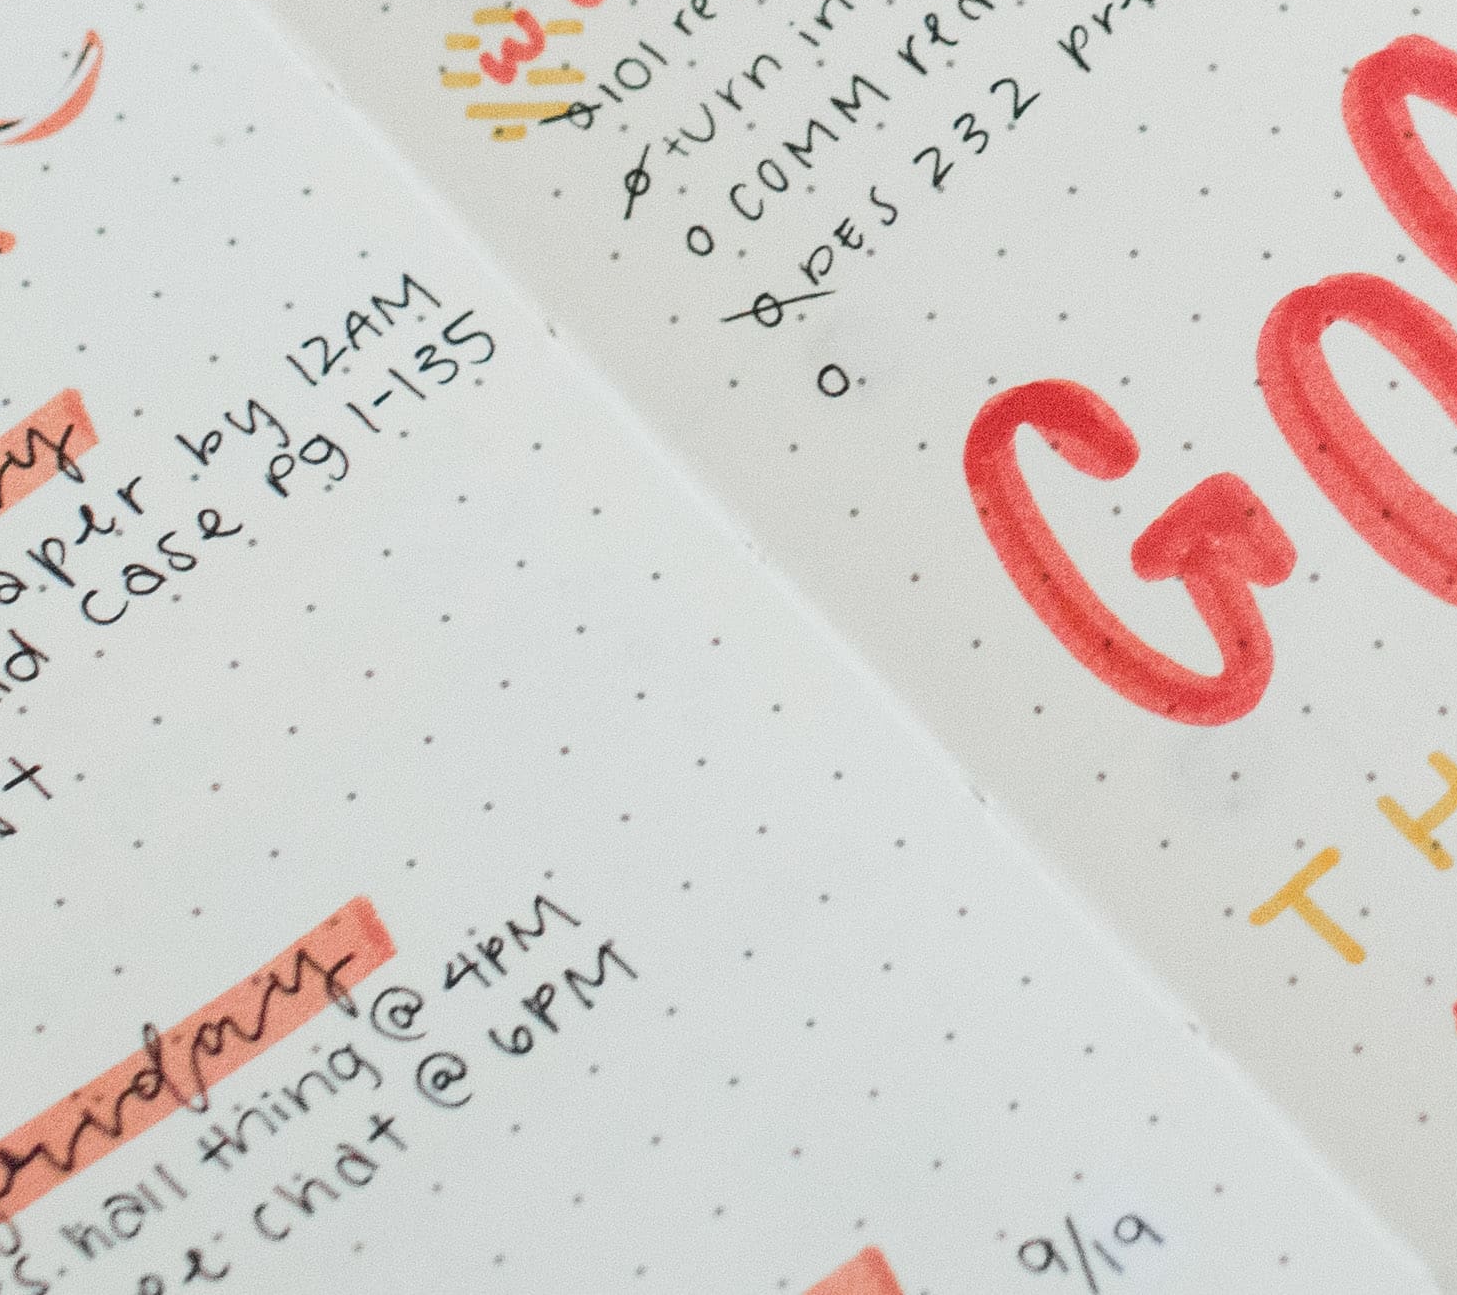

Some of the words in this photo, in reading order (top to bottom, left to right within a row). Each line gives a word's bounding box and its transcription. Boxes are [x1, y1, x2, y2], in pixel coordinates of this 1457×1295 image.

[670, 53, 786, 149] turn
[911, 76, 1041, 193] 232
[174, 398, 292, 468] by
[285, 272, 442, 388] 12AM
[78, 507, 244, 628] case
[263, 421, 350, 500] pg
[60, 1163, 188, 1260] hall
[189, 1042, 384, 1171] thing
[367, 984, 425, 1043] @
[442, 894, 582, 992] 4PM
[252, 1113, 407, 1243] chat
[413, 1050, 473, 1111] @
[486, 939, 639, 1058] 6PM
[1016, 1213, 1165, 1295] 9/19
